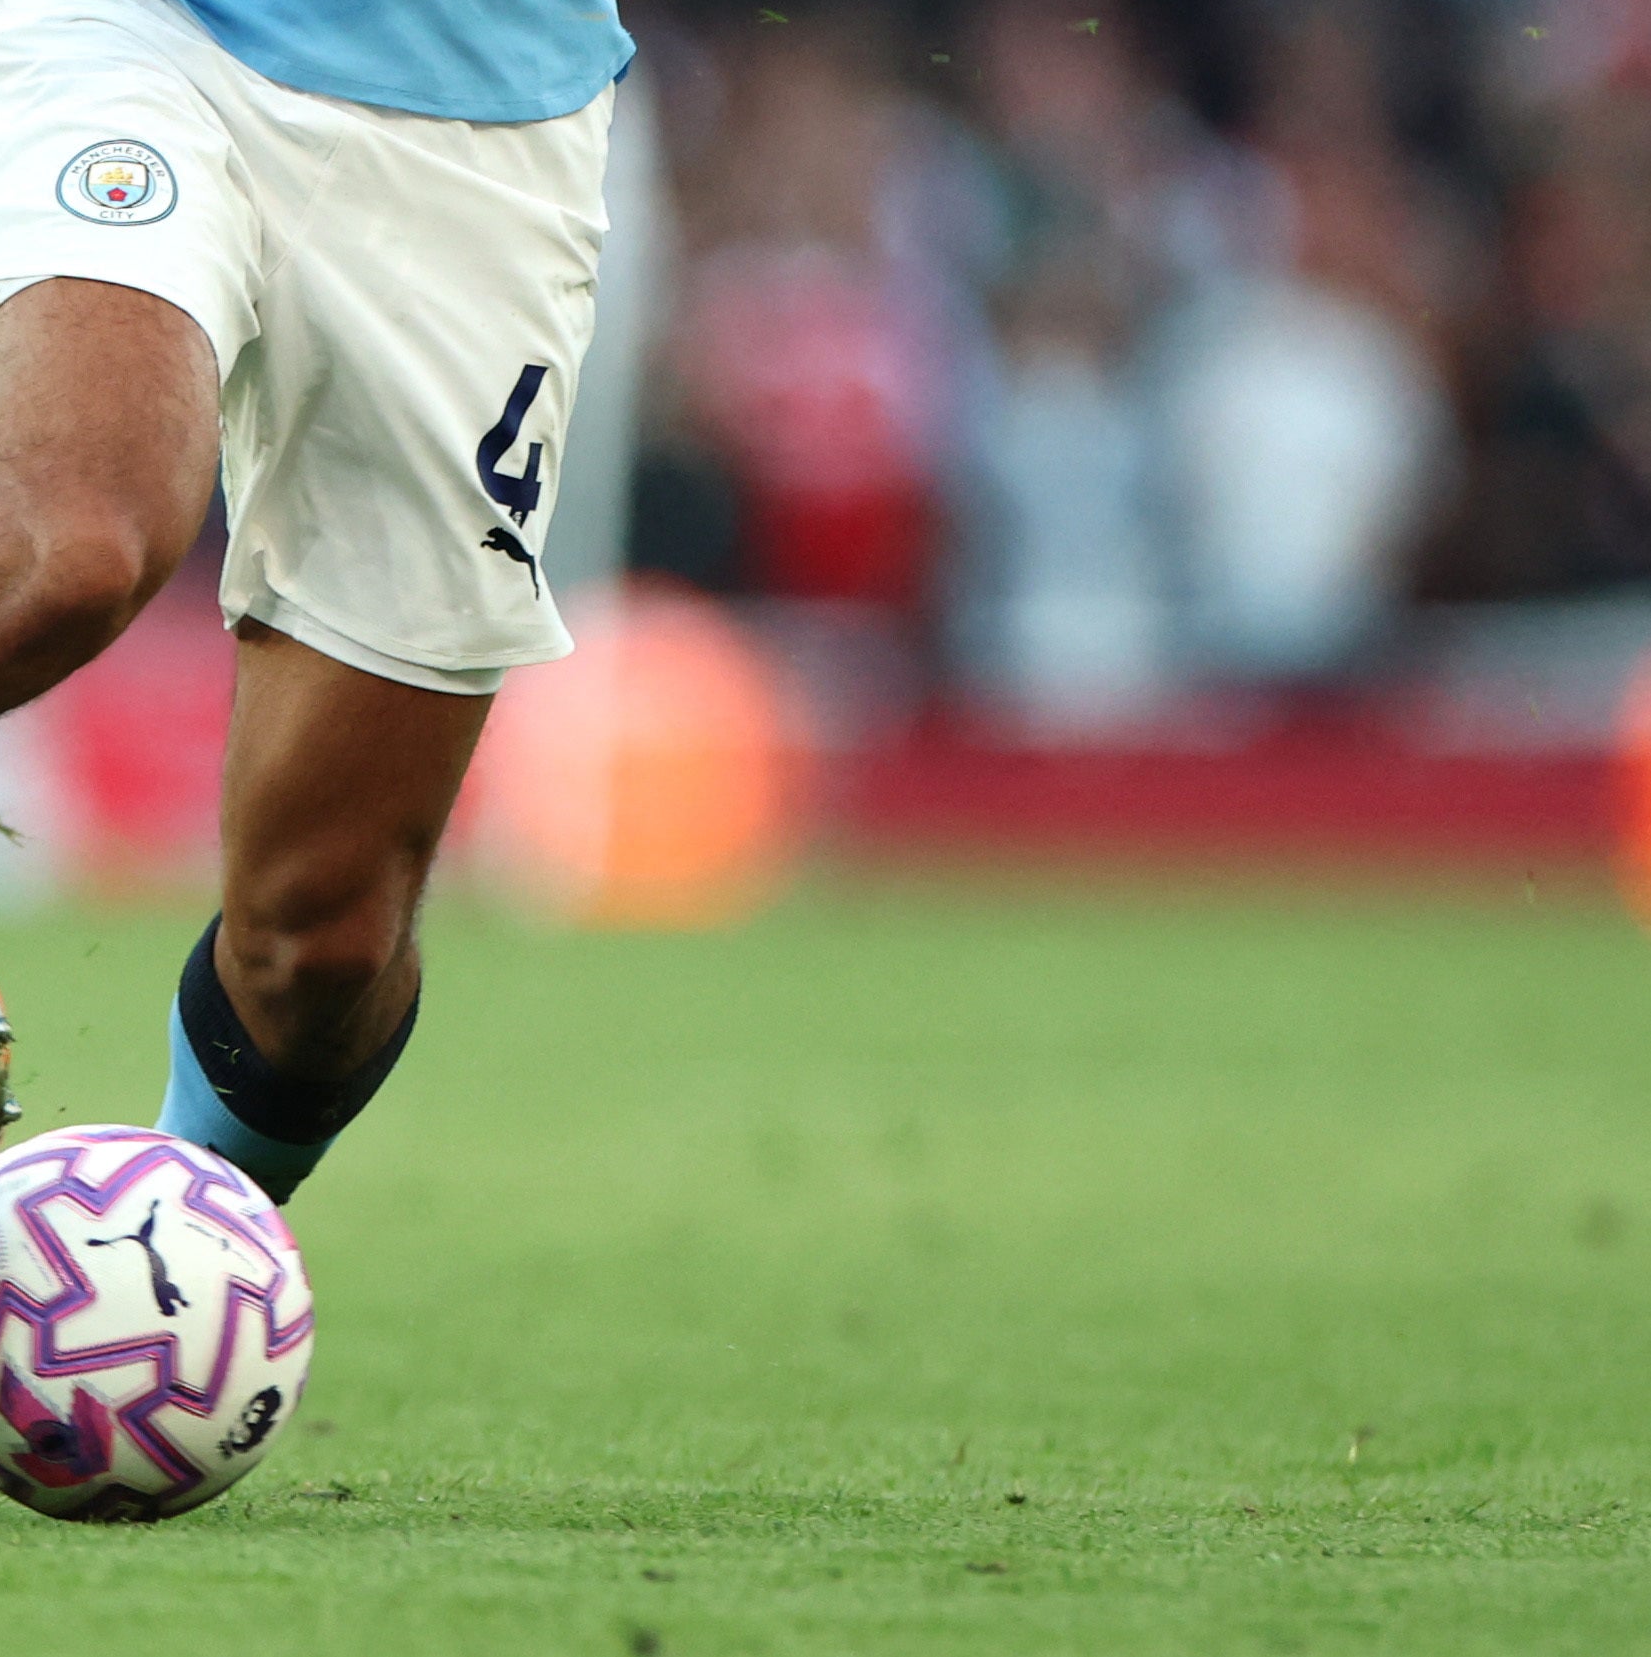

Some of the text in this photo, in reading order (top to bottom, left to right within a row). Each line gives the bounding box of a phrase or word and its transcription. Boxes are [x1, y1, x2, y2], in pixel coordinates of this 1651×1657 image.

[71, 146, 166, 178] MANCHESTER
[99, 210, 134, 220] CITY
[476, 363, 549, 529] 4
